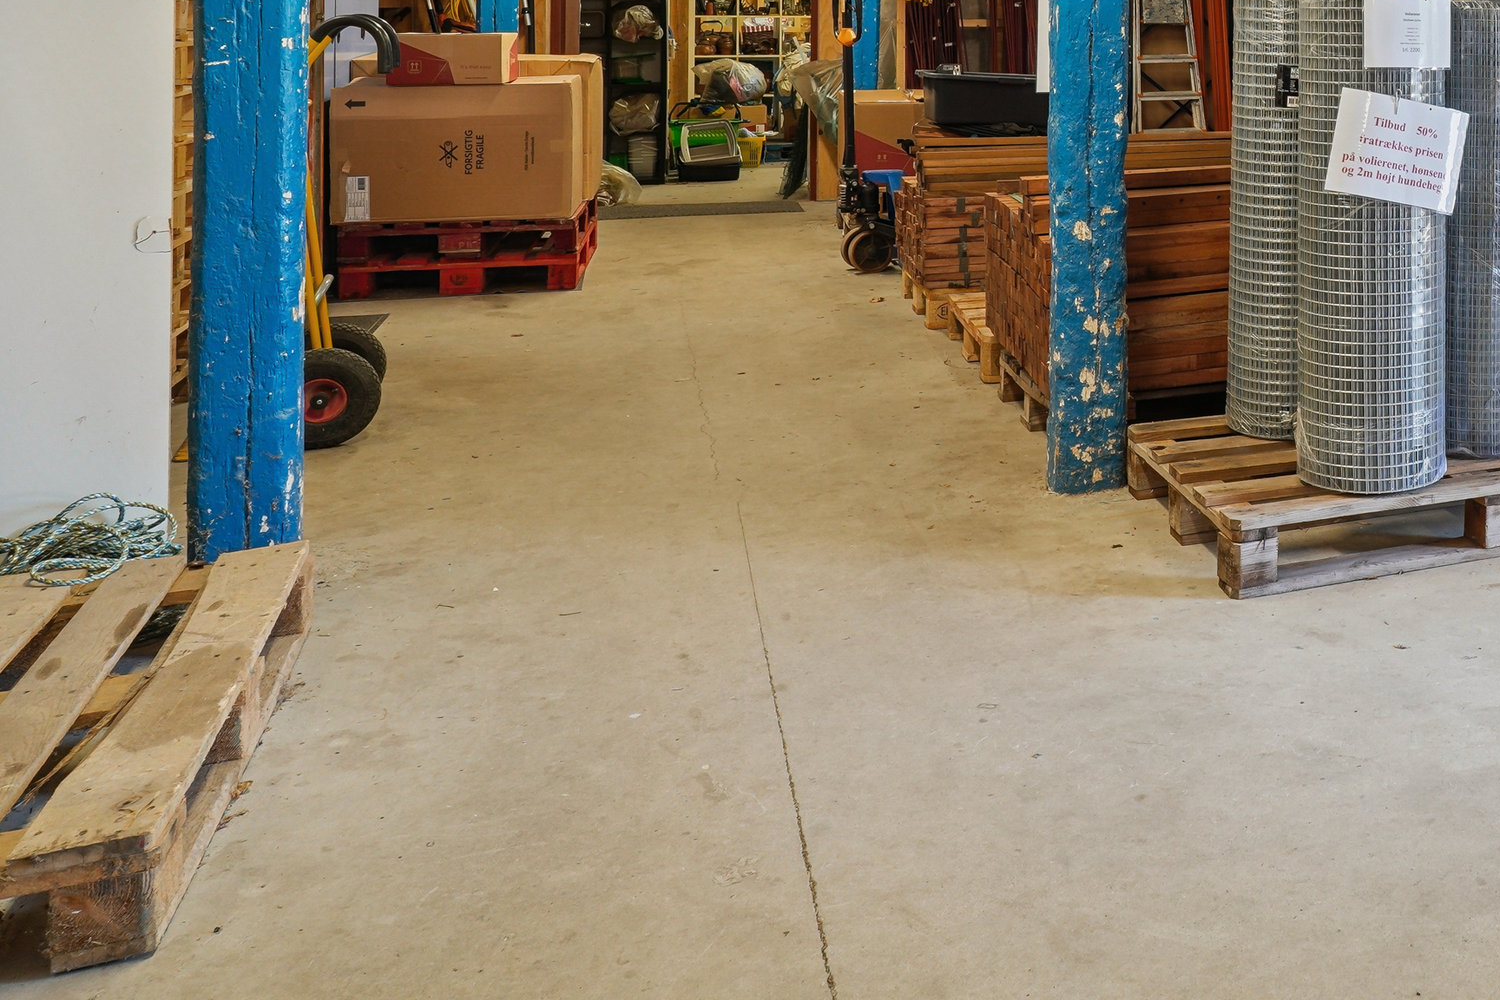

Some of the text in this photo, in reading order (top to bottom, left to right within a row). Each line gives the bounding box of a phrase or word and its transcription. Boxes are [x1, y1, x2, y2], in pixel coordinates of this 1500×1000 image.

[1373, 116, 1438, 139] Tilbud 50%
[464, 129, 473, 175] FORSIGTIG
[476, 134, 485, 170] FRAGILE
[1341, 152, 1356, 163] på
[1358, 155, 1409, 173] volierenet,
[1415, 147, 1444, 160] prisen
[1341, 166, 1443, 194] og 2m højt hundeheg
